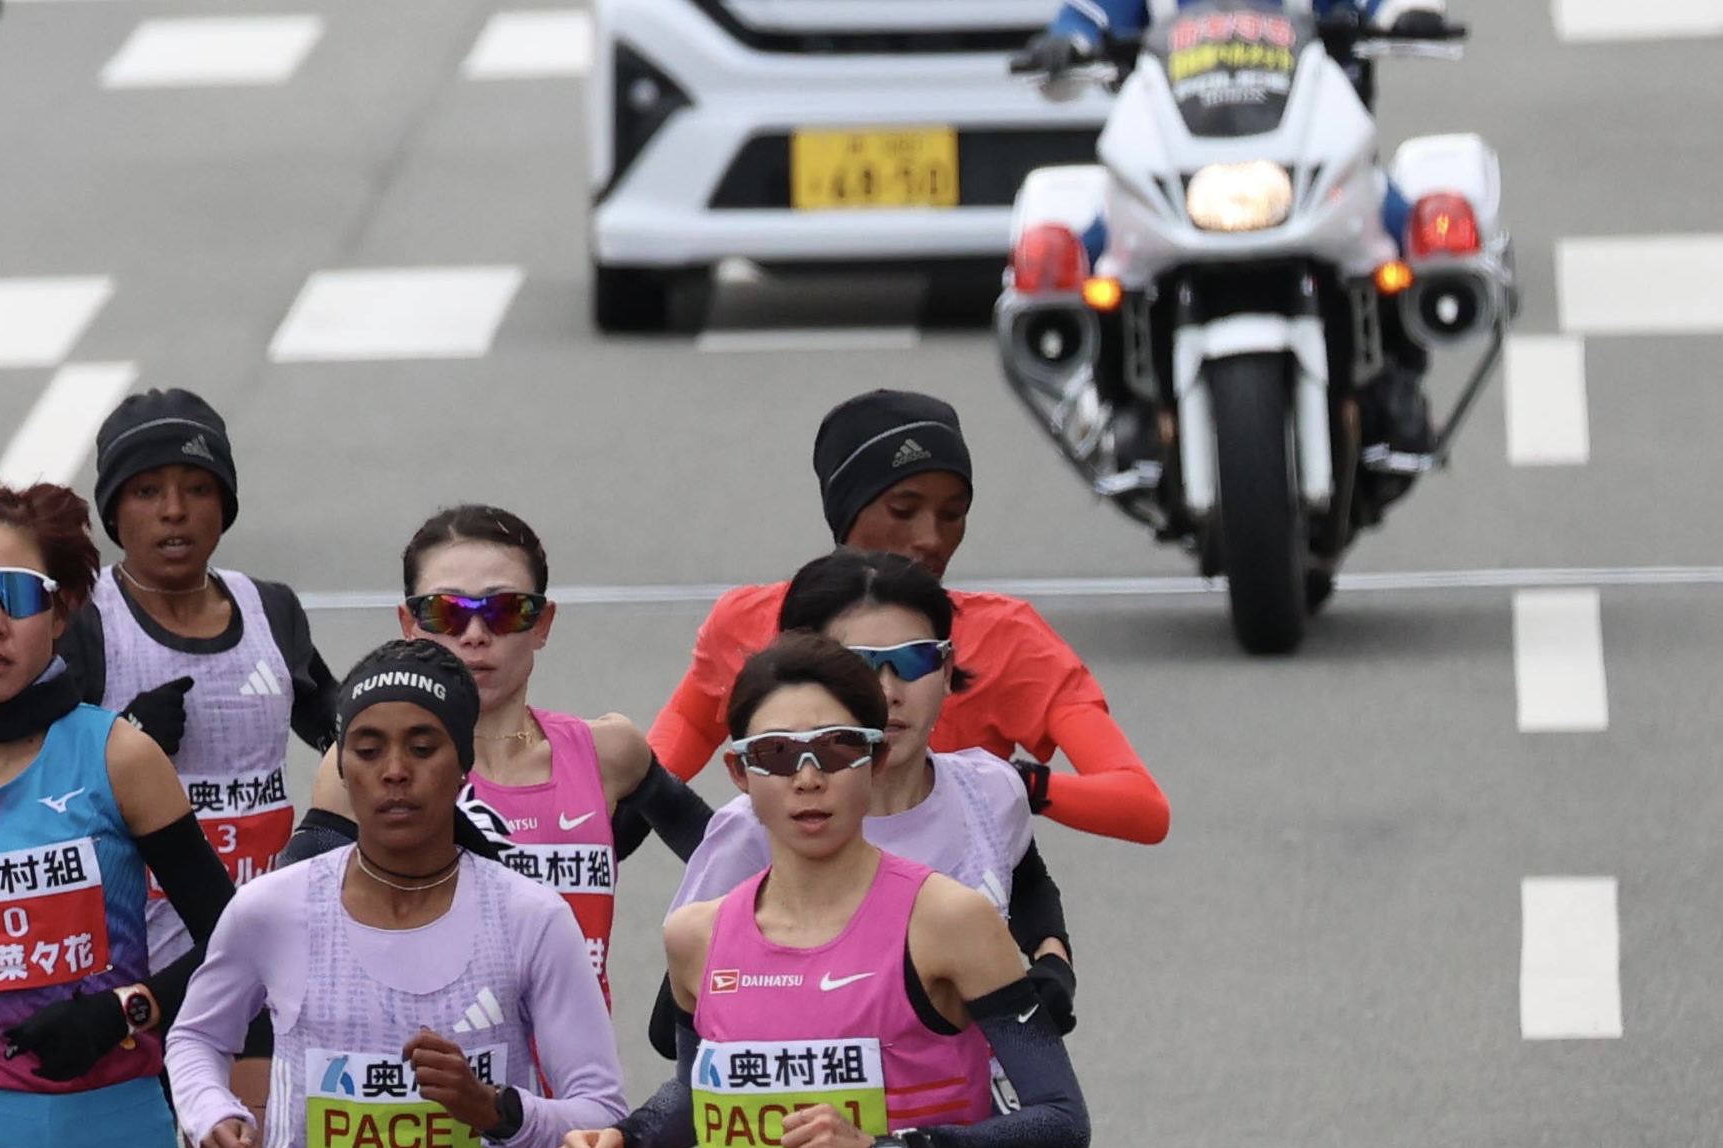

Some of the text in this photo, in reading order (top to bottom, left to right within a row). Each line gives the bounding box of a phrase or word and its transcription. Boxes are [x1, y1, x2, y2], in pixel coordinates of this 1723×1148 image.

[351, 671, 447, 701] RUNNING
[188, 767, 287, 813] 奥村組
[217, 823, 238, 854] 3
[741, 974, 804, 988] DAIHATSU
[728, 1045, 868, 1088] 奥村組
